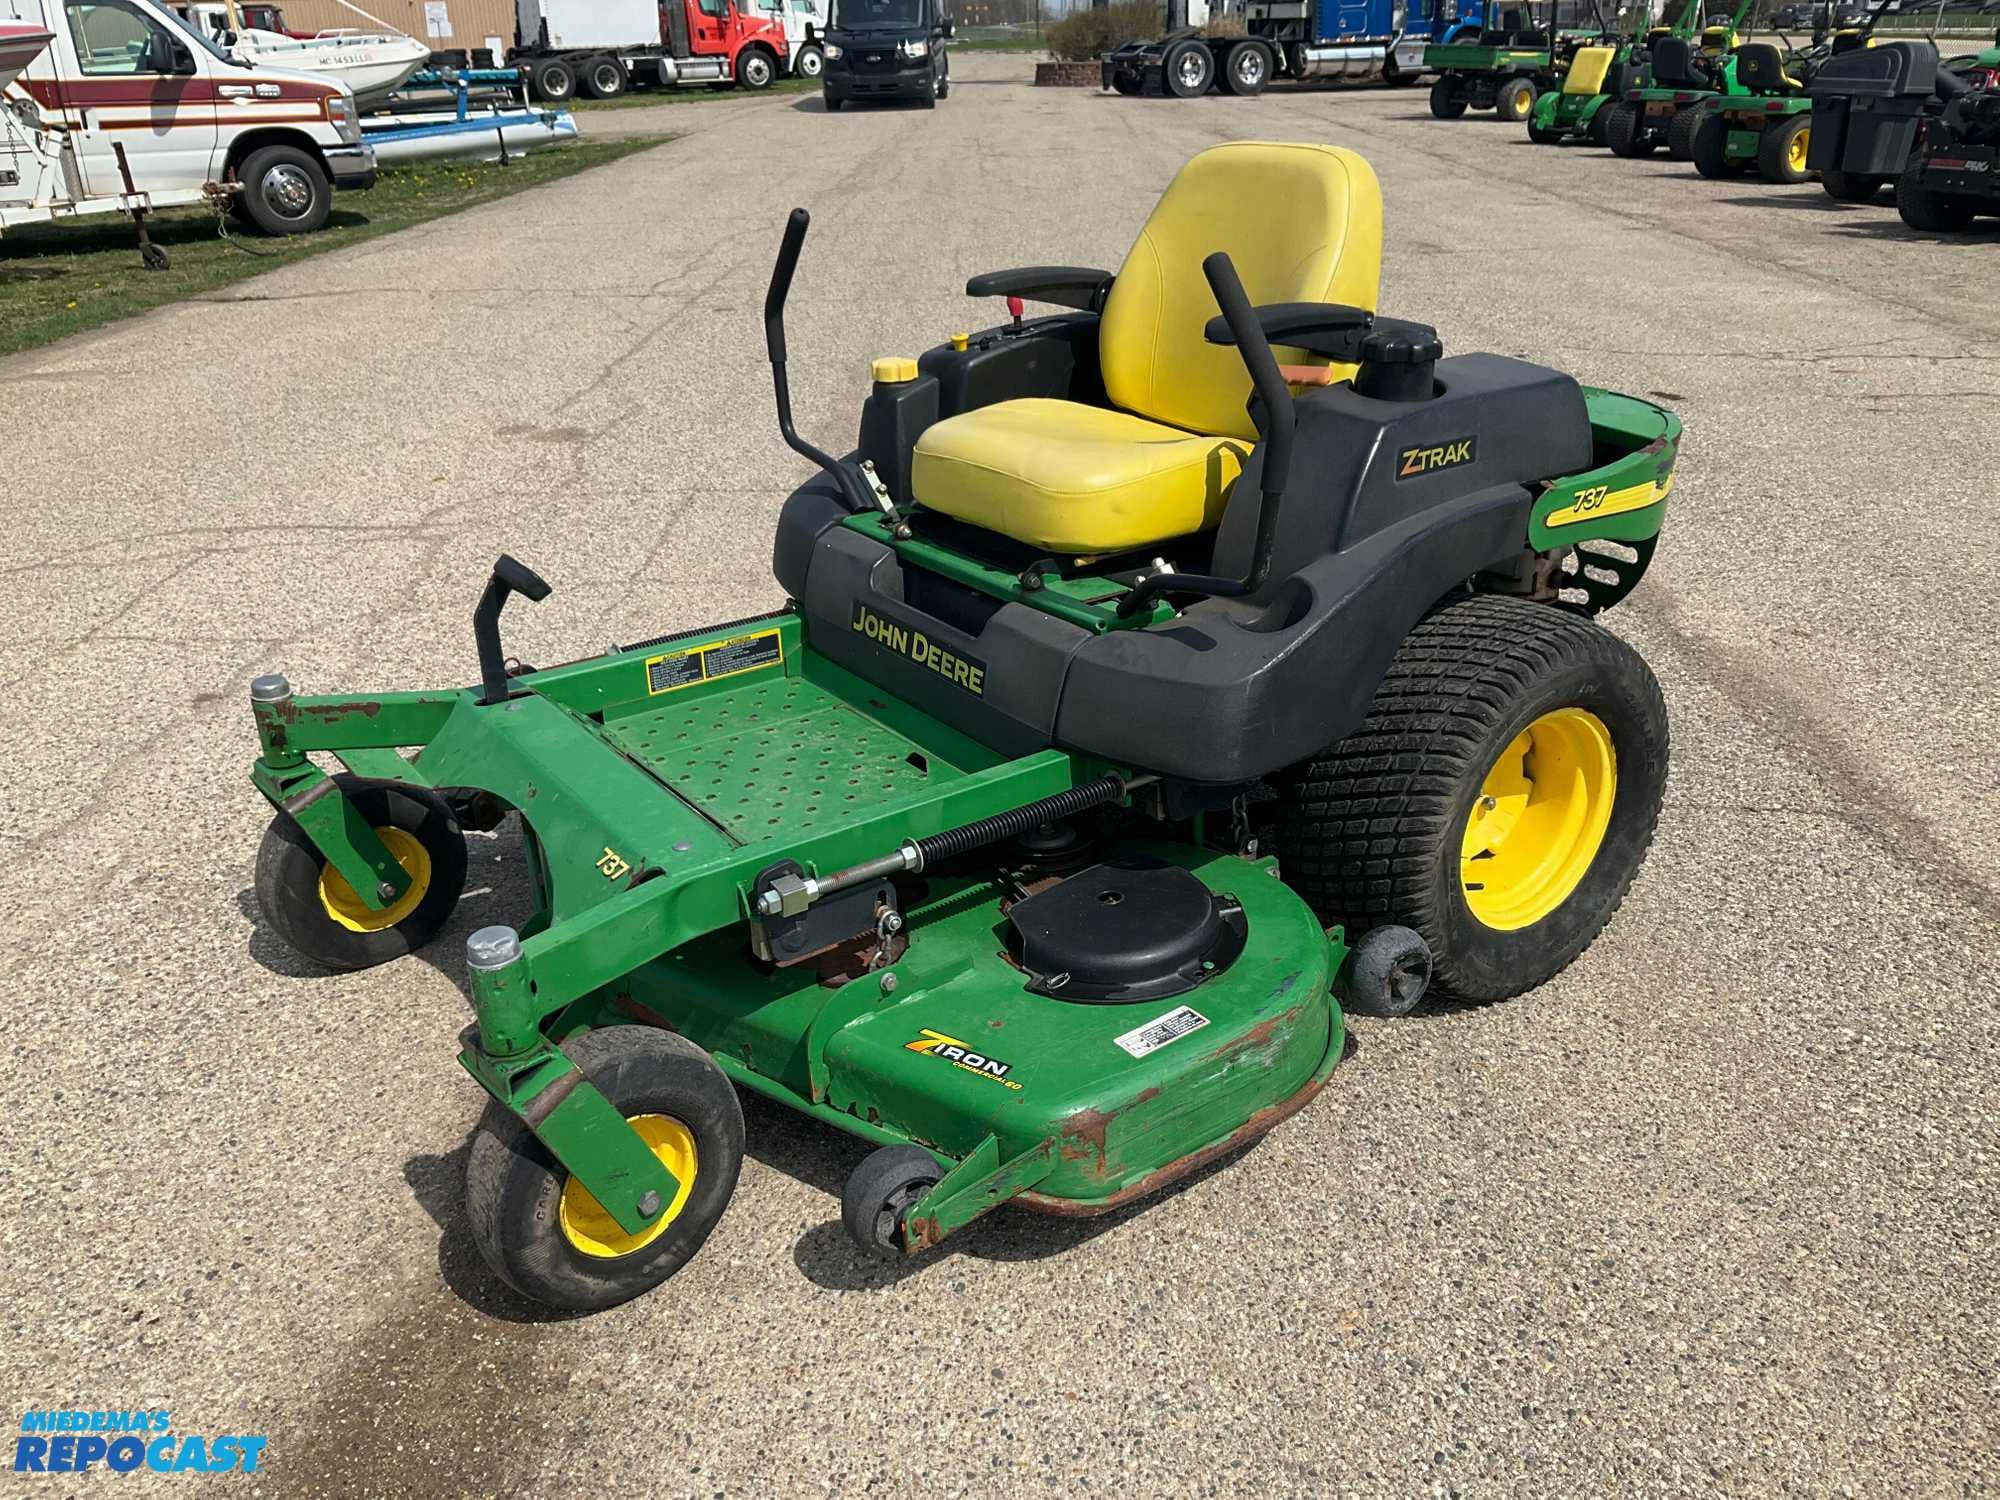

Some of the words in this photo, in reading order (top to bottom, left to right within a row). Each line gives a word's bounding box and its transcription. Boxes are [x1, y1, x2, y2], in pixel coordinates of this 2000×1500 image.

[1399, 440, 1472, 476] ZTRAK
[1572, 486, 1609, 513] 737
[852, 605, 909, 655] JOHN
[911, 631, 984, 695] DEERE
[595, 846, 631, 882] 737
[952, 1060, 1006, 1085] COMMERCIAL
